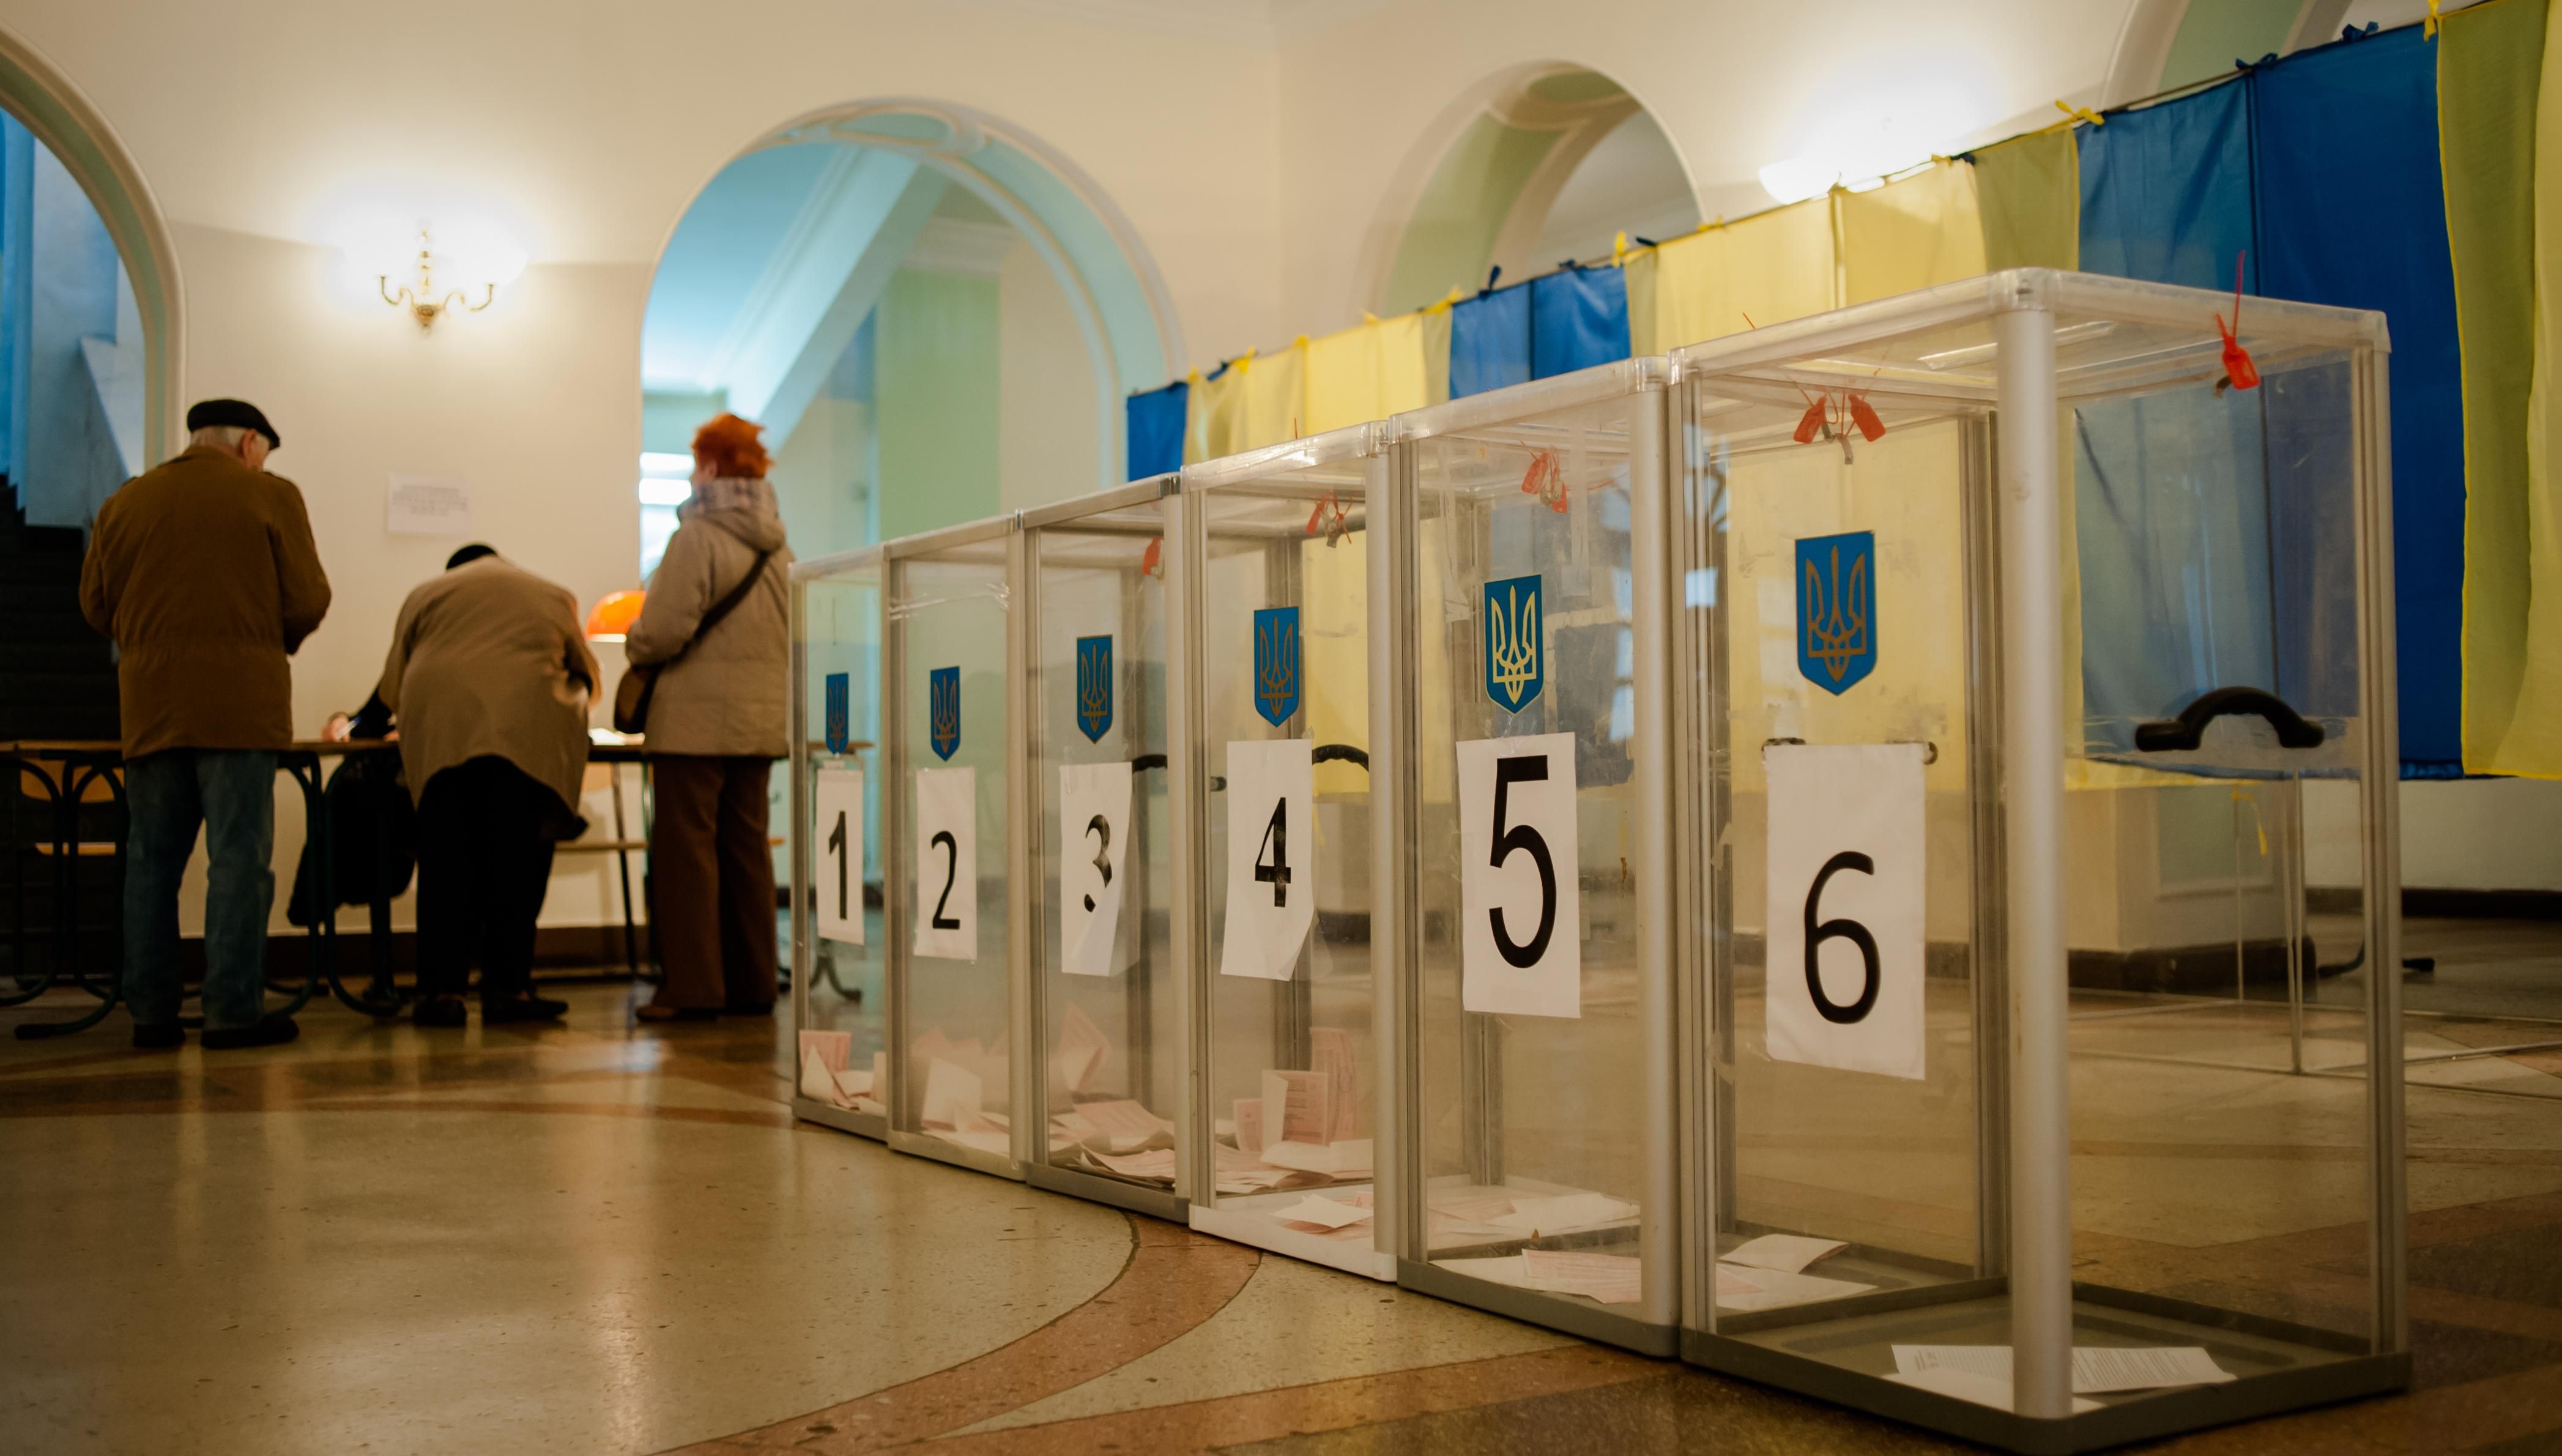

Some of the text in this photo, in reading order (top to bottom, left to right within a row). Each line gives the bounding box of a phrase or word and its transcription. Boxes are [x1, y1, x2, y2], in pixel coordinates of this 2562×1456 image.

[829, 811, 847, 920] 1
[931, 830, 960, 930] 2
[1083, 814, 1112, 913] 3
[1255, 797, 1291, 908] 4
[1488, 754, 1557, 968] 5
[1804, 851, 1881, 1025] 6
